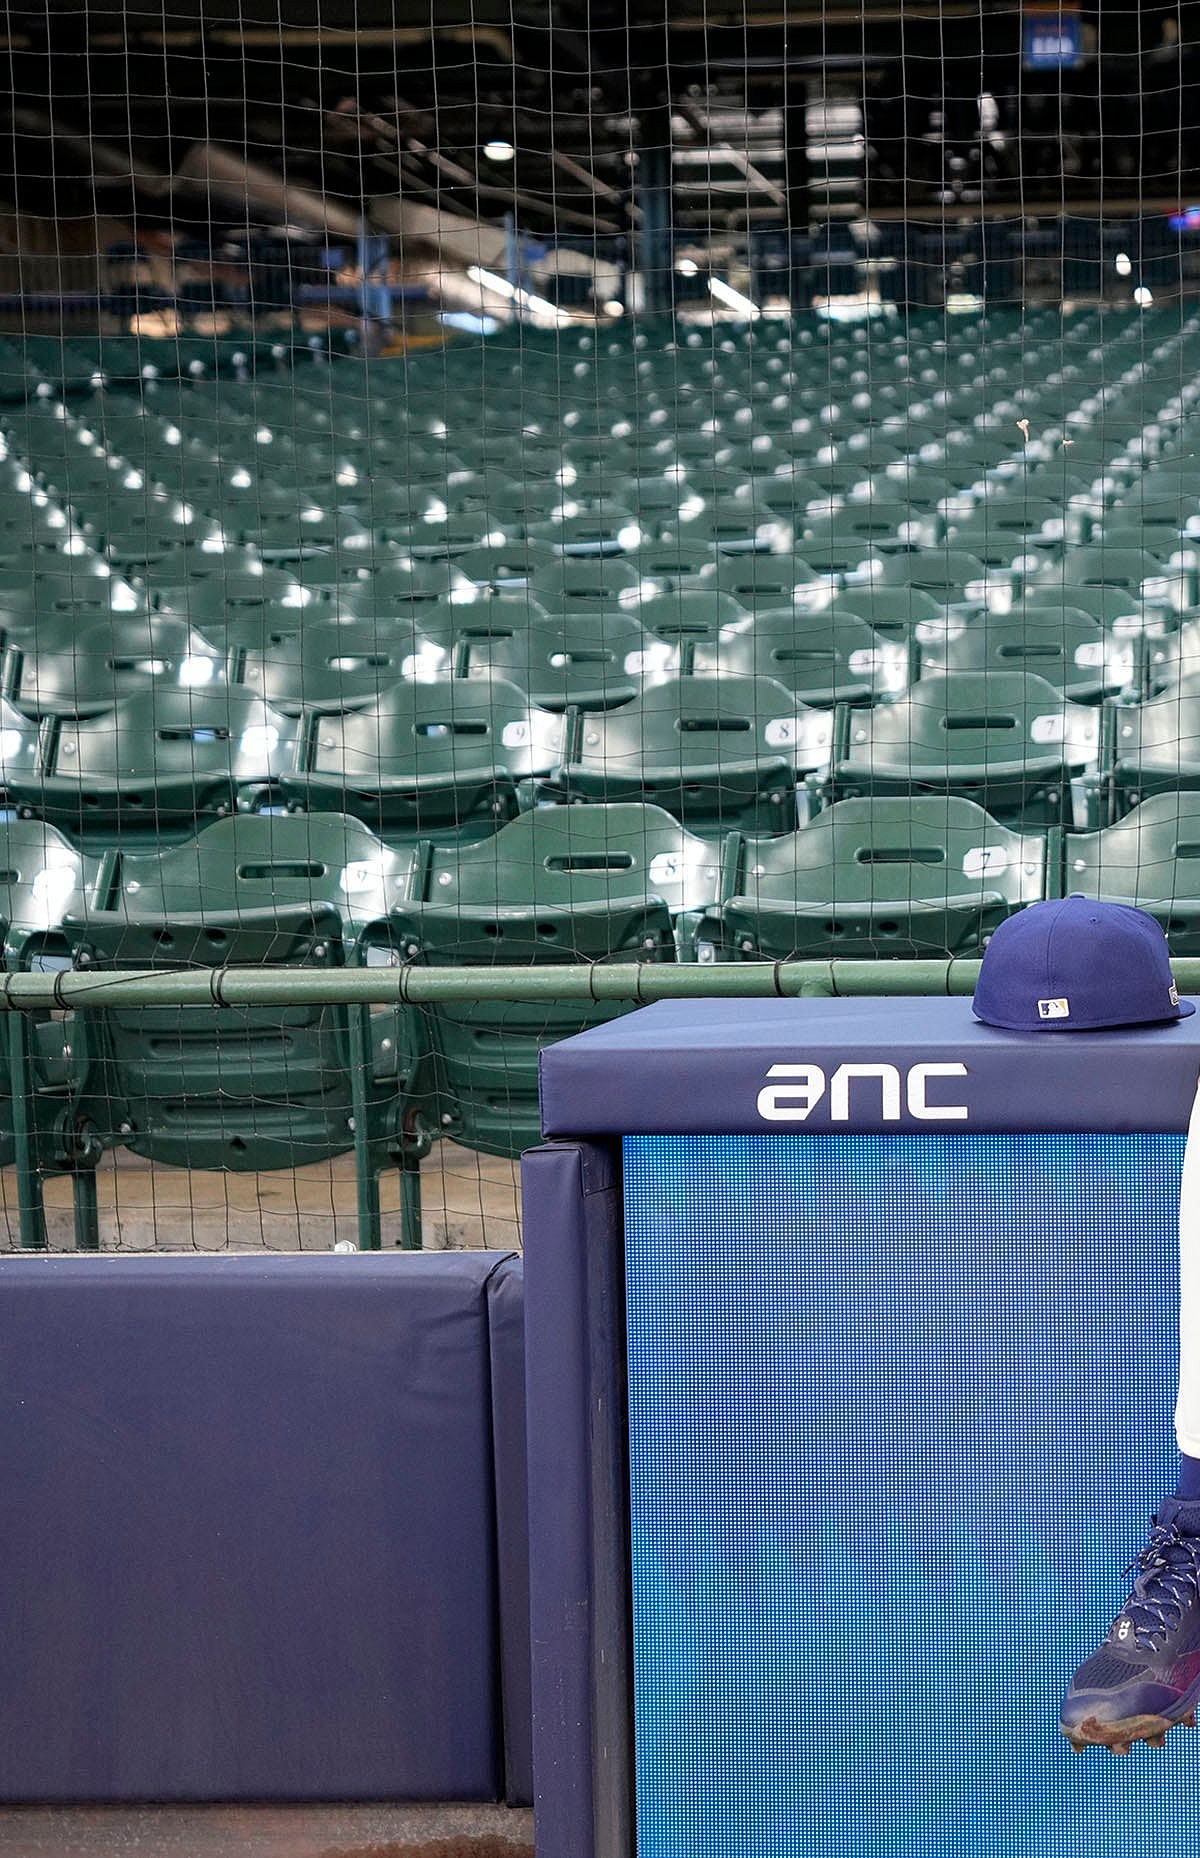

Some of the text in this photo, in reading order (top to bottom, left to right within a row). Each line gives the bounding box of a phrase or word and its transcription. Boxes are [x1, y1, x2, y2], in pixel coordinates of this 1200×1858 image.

[779, 722, 790, 739] 8
[1046, 719, 1056, 735] 7
[664, 857, 676, 877] 8
[981, 851, 991, 868] 7
[757, 1063, 968, 1120] anc
